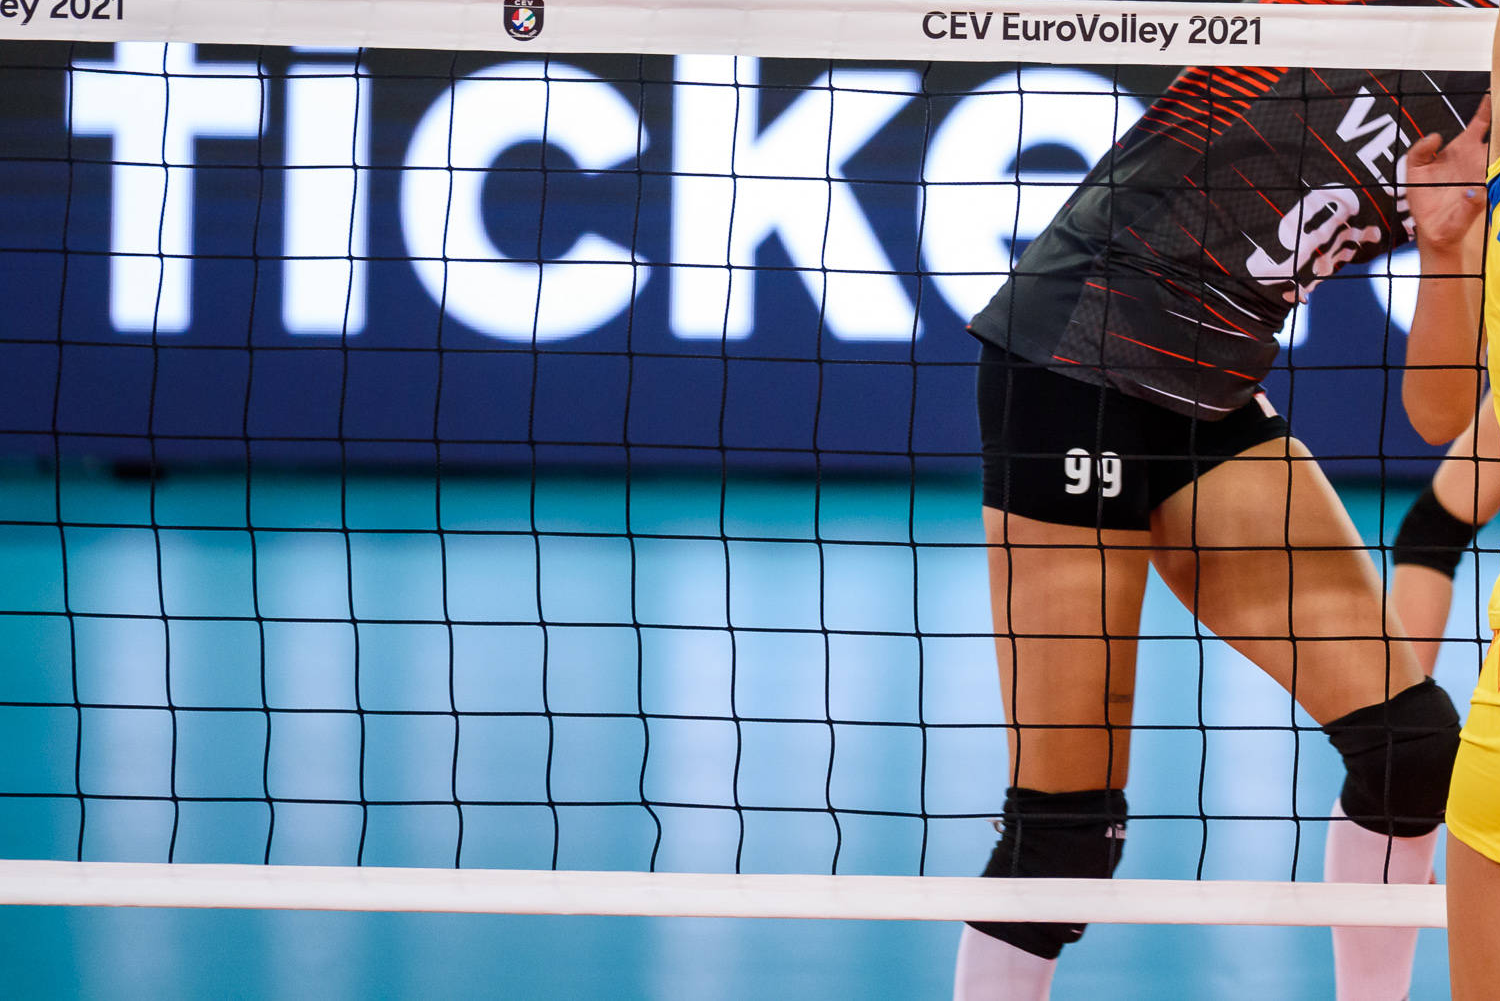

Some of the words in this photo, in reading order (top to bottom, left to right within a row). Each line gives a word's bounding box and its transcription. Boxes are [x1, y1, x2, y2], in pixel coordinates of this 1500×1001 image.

[922, 10, 993, 40] CEV
[1002, 12, 1179, 52] EuroVolley
[1188, 15, 1261, 45] 2021
[1064, 447, 1122, 498] 99
